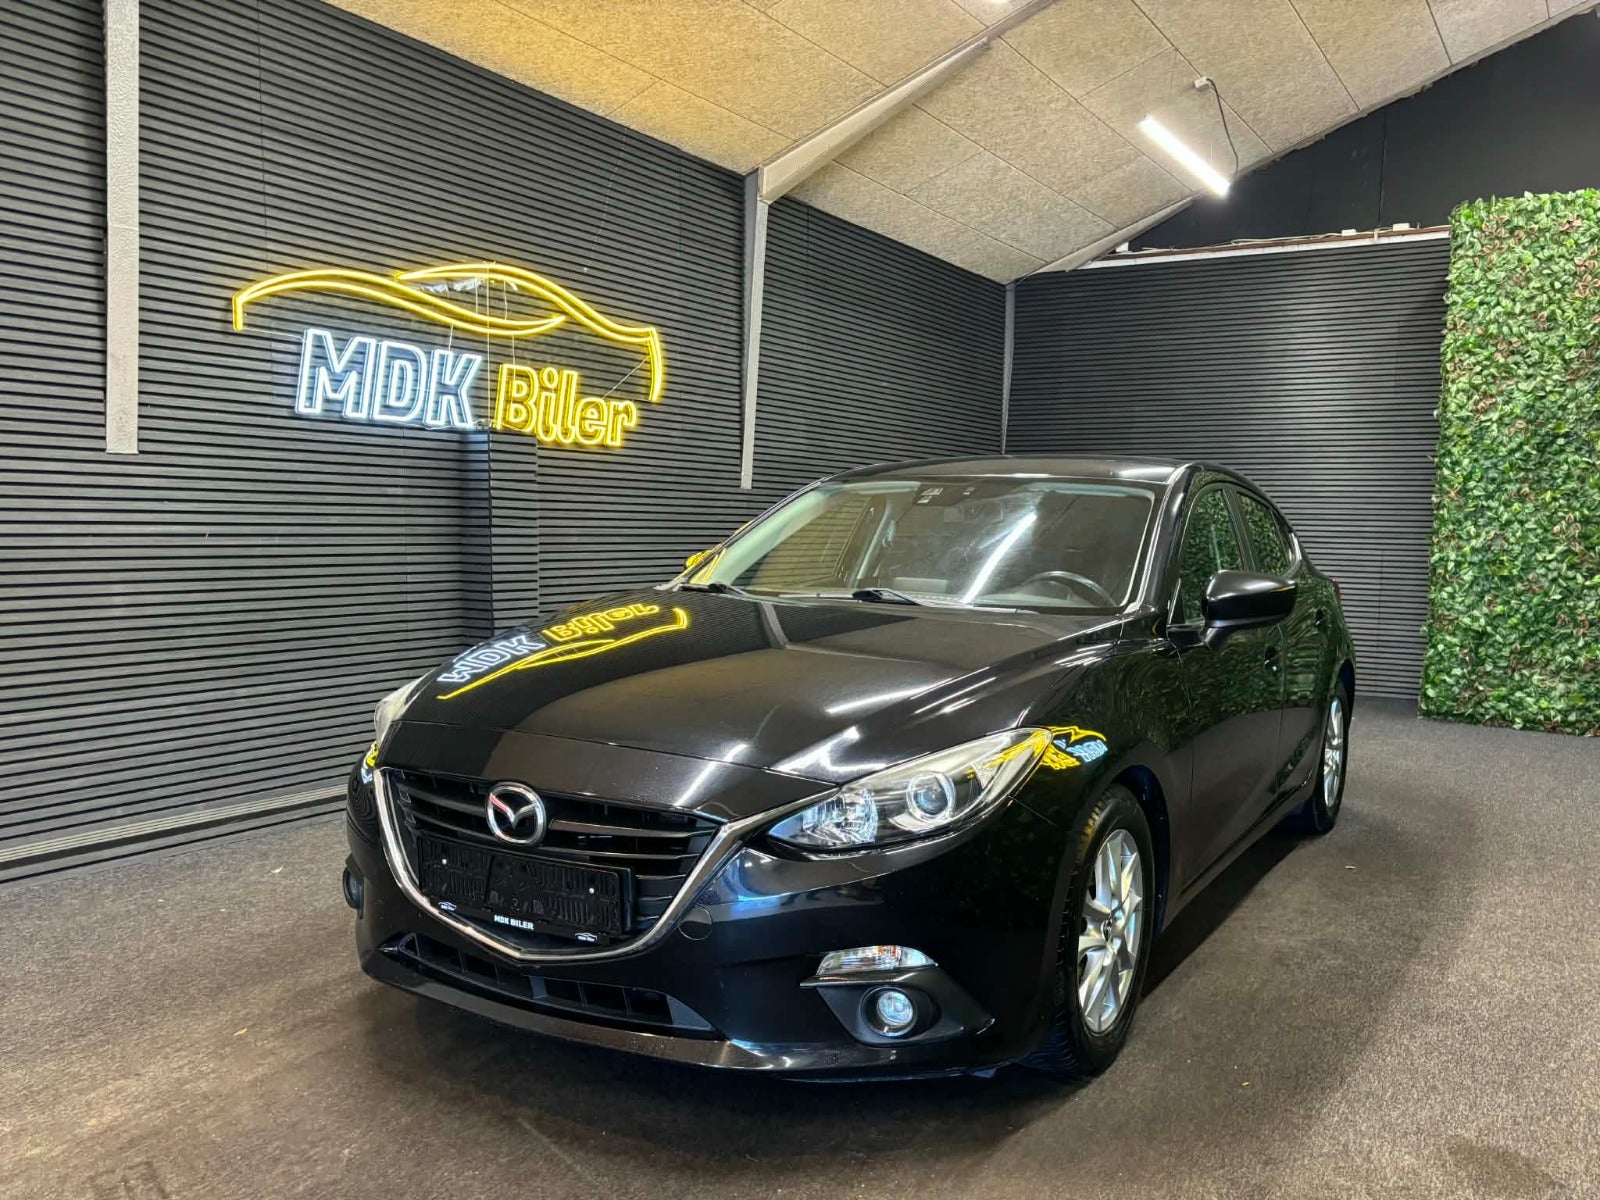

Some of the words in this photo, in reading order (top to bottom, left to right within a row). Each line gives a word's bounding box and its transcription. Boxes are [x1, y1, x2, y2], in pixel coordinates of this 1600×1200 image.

[295, 328, 482, 428] MDK
[493, 363, 637, 447] Biler
[494, 914, 509, 925] MDK
[510, 918, 534, 931] BILER
